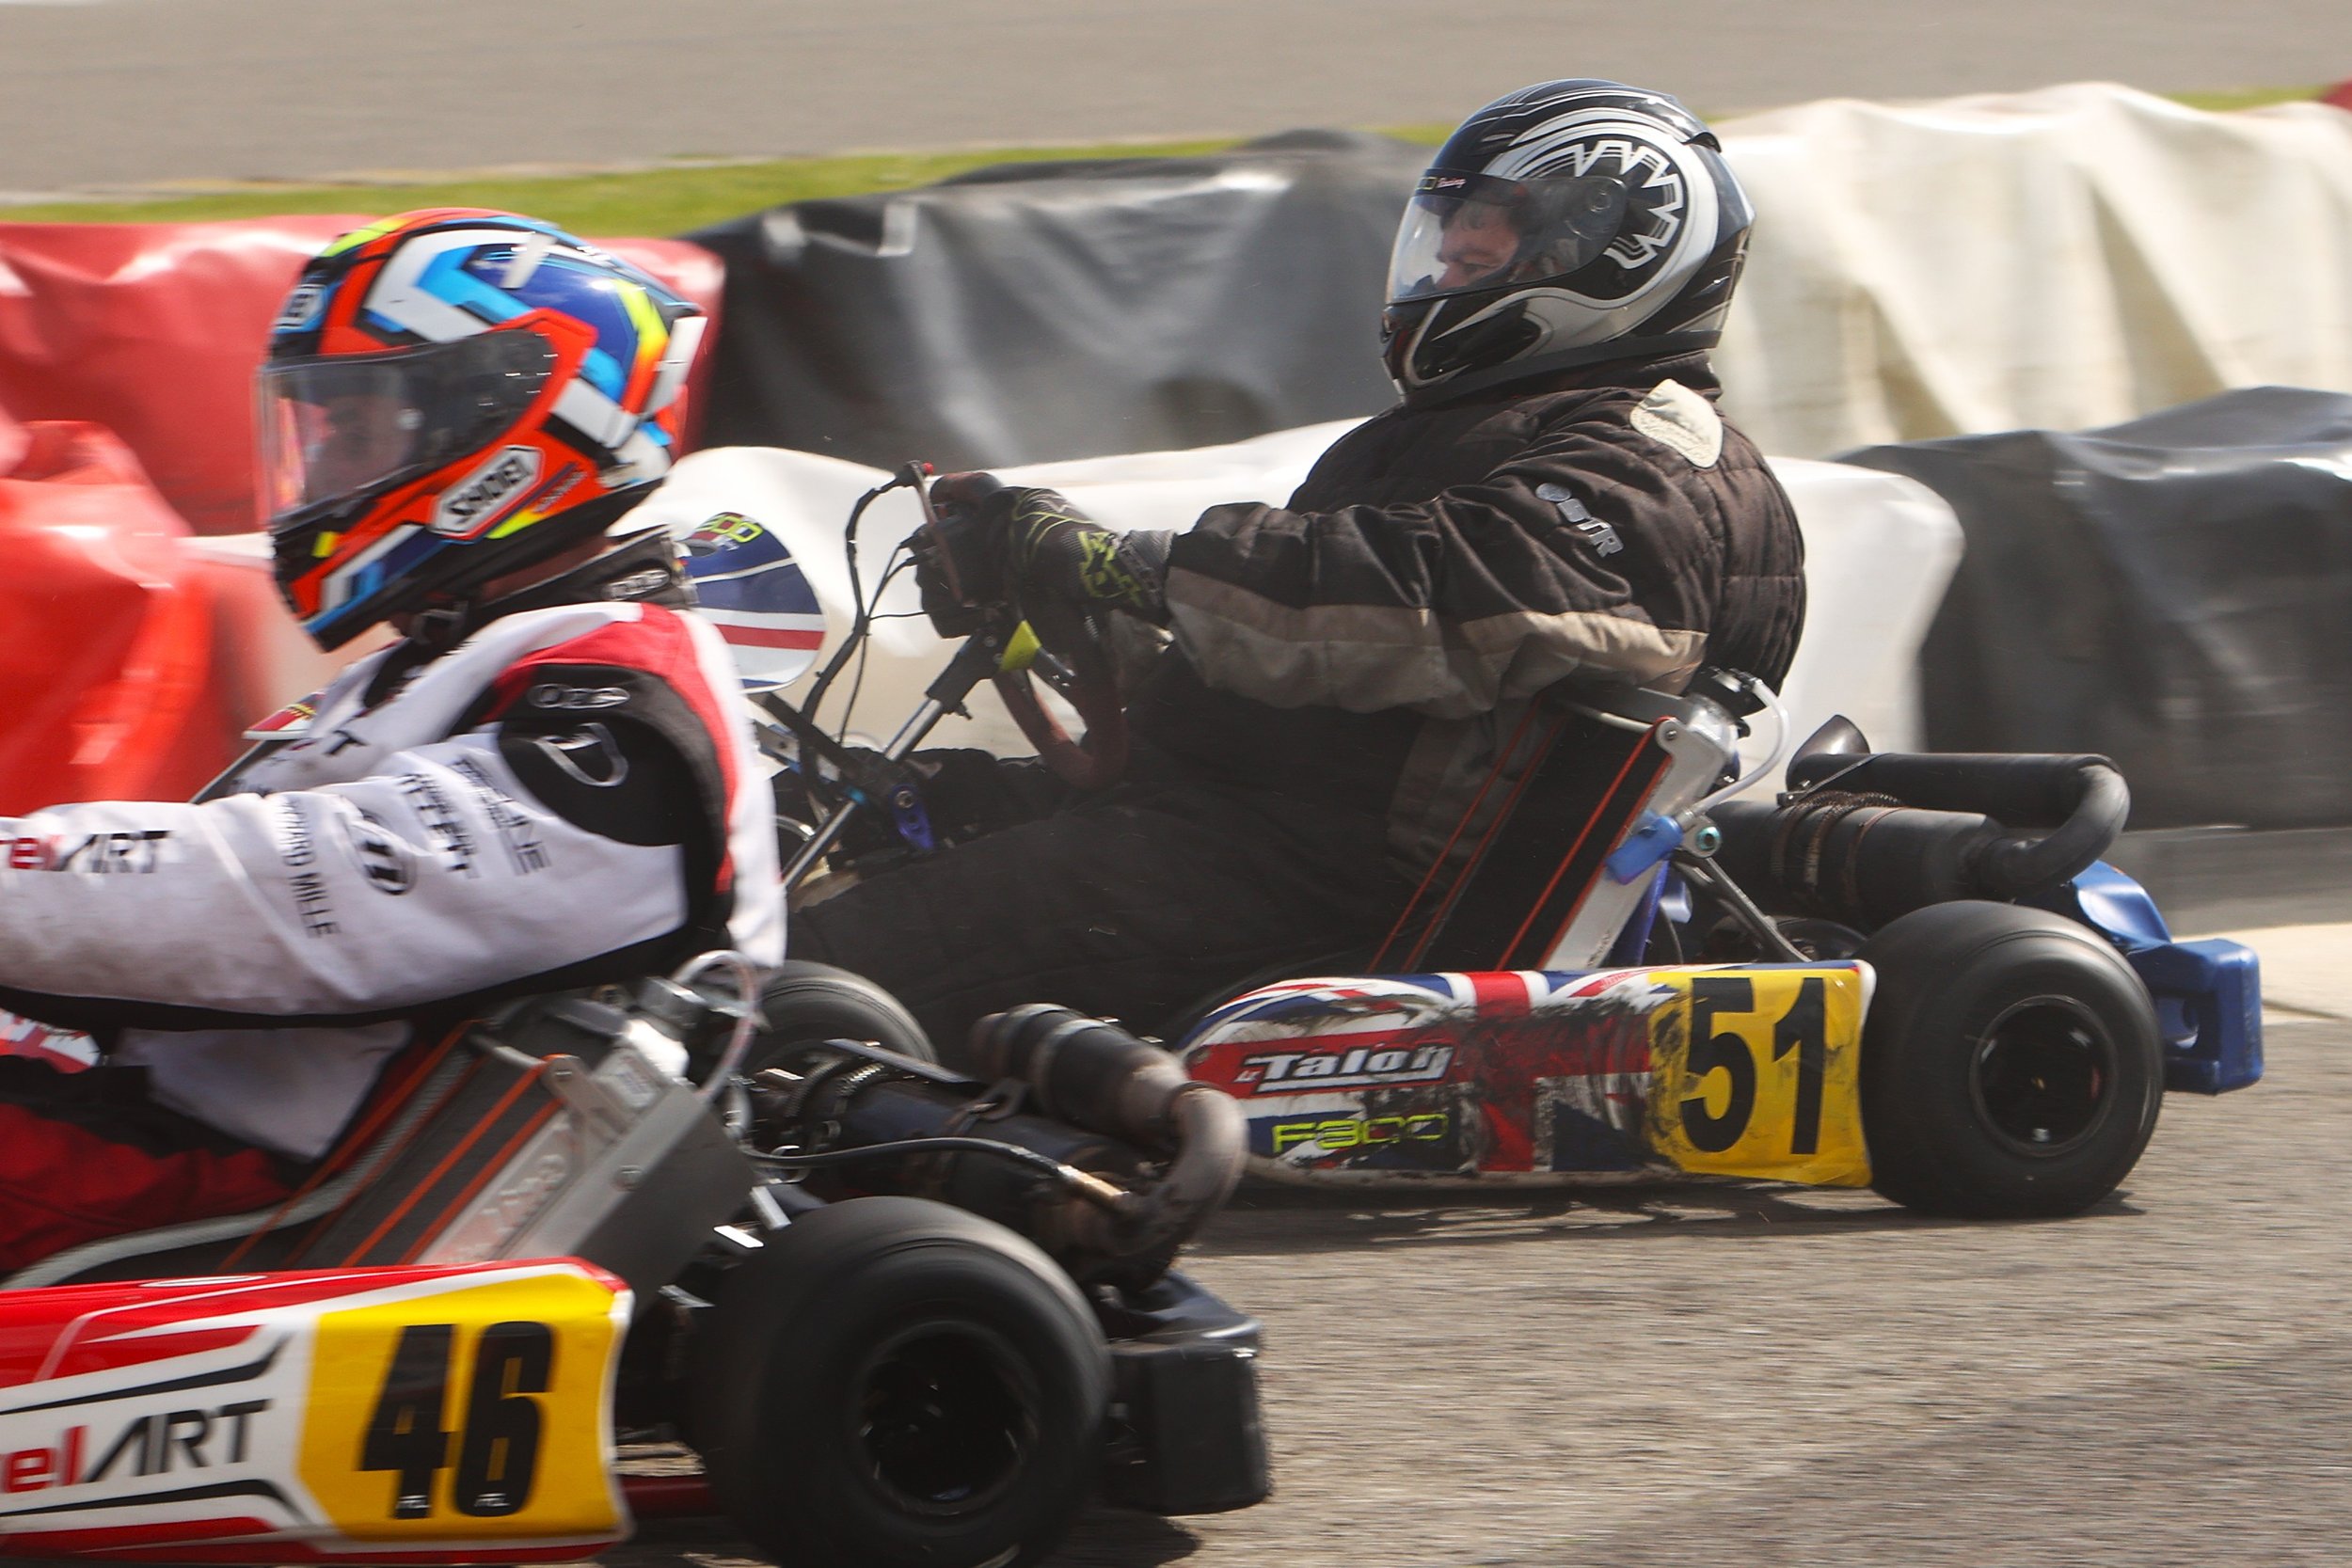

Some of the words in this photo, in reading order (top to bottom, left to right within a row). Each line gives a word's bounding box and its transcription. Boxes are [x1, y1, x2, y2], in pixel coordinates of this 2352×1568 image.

[0, 830, 171, 873] elART
[288, 871, 342, 939] MILLE
[1679, 977, 1827, 1156] 51
[359, 1320, 554, 1520] 46
